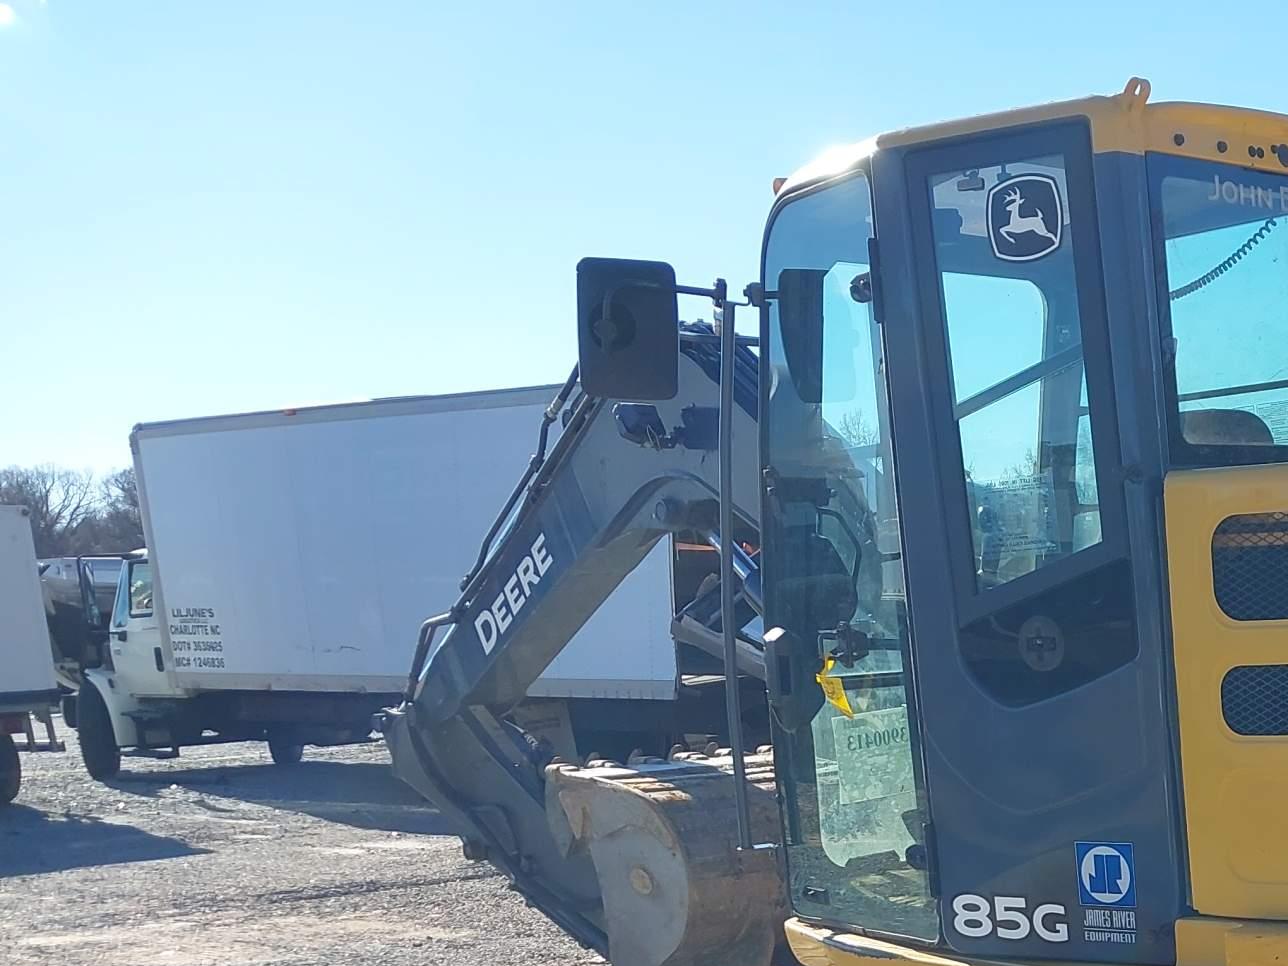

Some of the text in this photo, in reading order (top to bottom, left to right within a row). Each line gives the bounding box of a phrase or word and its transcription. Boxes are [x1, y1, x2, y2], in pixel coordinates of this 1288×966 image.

[1208, 174, 1273, 210] JOHN
[474, 532, 554, 656] DEERE
[170, 624, 221, 635] CHARLOTTE NC
[952, 893, 1069, 942] 85G
[1083, 909, 1136, 929] JAMES RIVER
